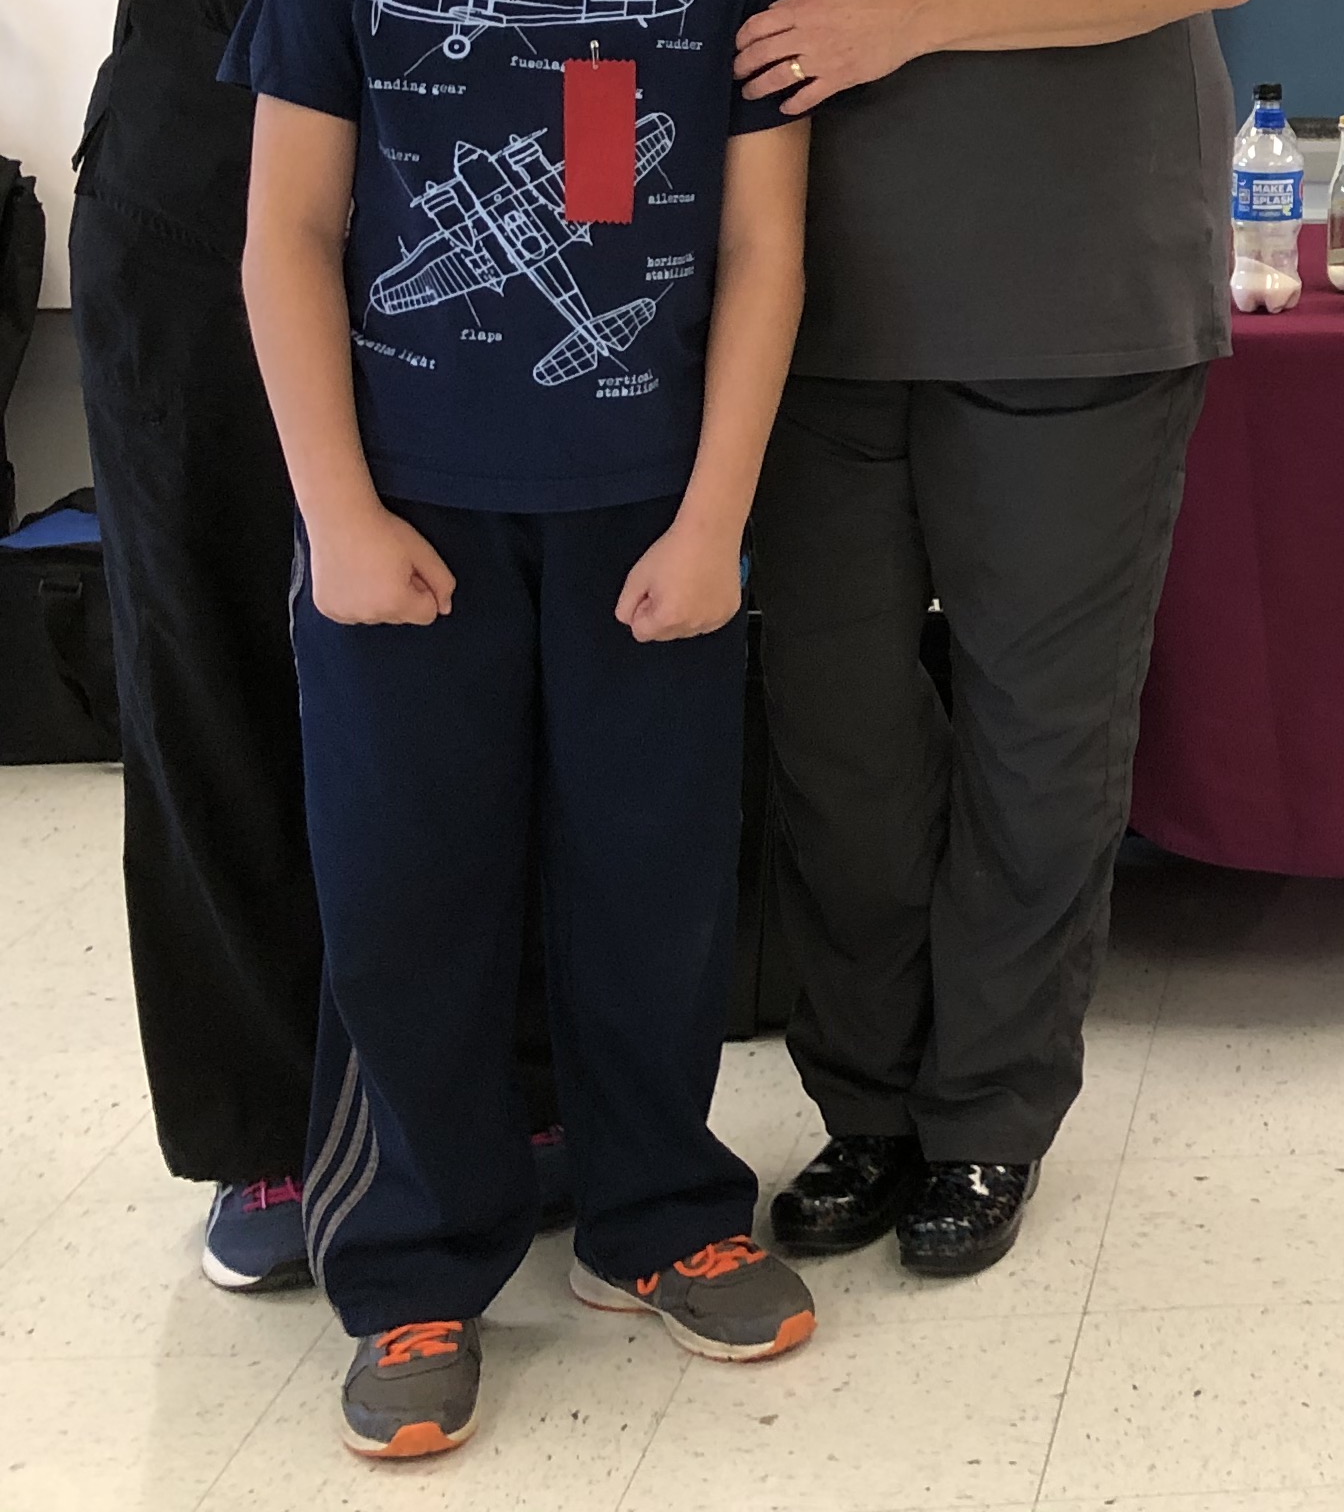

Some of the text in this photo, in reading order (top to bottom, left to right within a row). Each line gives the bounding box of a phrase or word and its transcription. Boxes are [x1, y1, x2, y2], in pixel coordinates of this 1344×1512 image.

[656, 38, 703, 51] rudder
[368, 76, 467, 96] landing gear
[1253, 183, 1294, 193] MAKE A
[647, 192, 696, 205] ailerons
[1252, 195, 1294, 205] SPLASH
[459, 328, 503, 344] flaps
[397, 349, 436, 371] light
[597, 368, 654, 387] vertical
